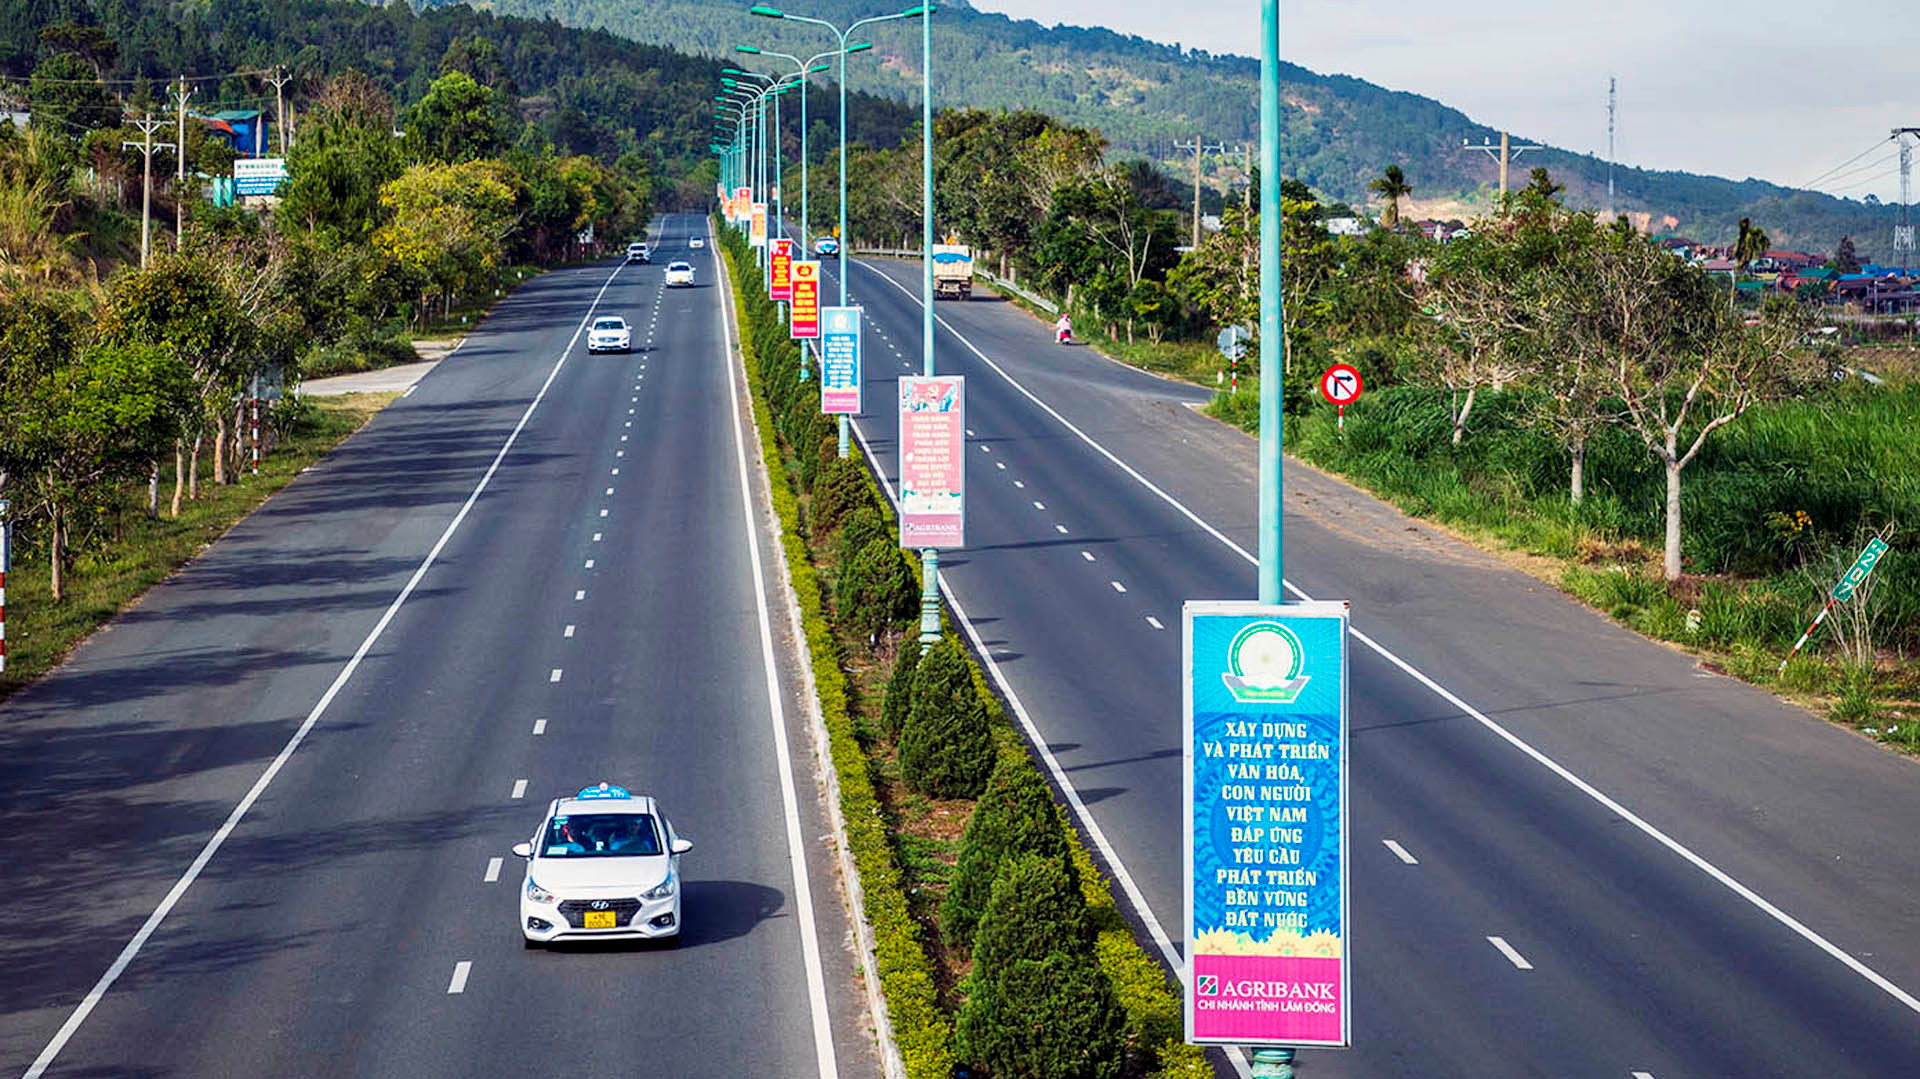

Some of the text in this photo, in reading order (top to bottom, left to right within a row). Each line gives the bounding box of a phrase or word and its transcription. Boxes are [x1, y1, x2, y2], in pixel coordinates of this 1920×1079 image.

[1225, 720, 1307, 740] XÂY DỰNG
[1203, 740, 1225, 758] VÀ
[1229, 741, 1275, 759] PHÁT
[1266, 763, 1305, 784] HÓA,
[1222, 783, 1312, 802] CON NGƯỜI
[1225, 804, 1308, 824] VIỆT NAM
[1231, 825, 1265, 843] ĐÁP
[1233, 846, 1300, 865] YÊU CẦU
[1216, 867, 1262, 885] PHÁT
[1226, 888, 1259, 906] BỀN
[1225, 909, 1260, 927] ĐẤT
[1221, 979, 1336, 1000] AGRIBANK
[1197, 999, 1216, 1011] CHI
[1217, 998, 1254, 1012] NHÁNH
[1280, 1000, 1303, 1013] LÂM
